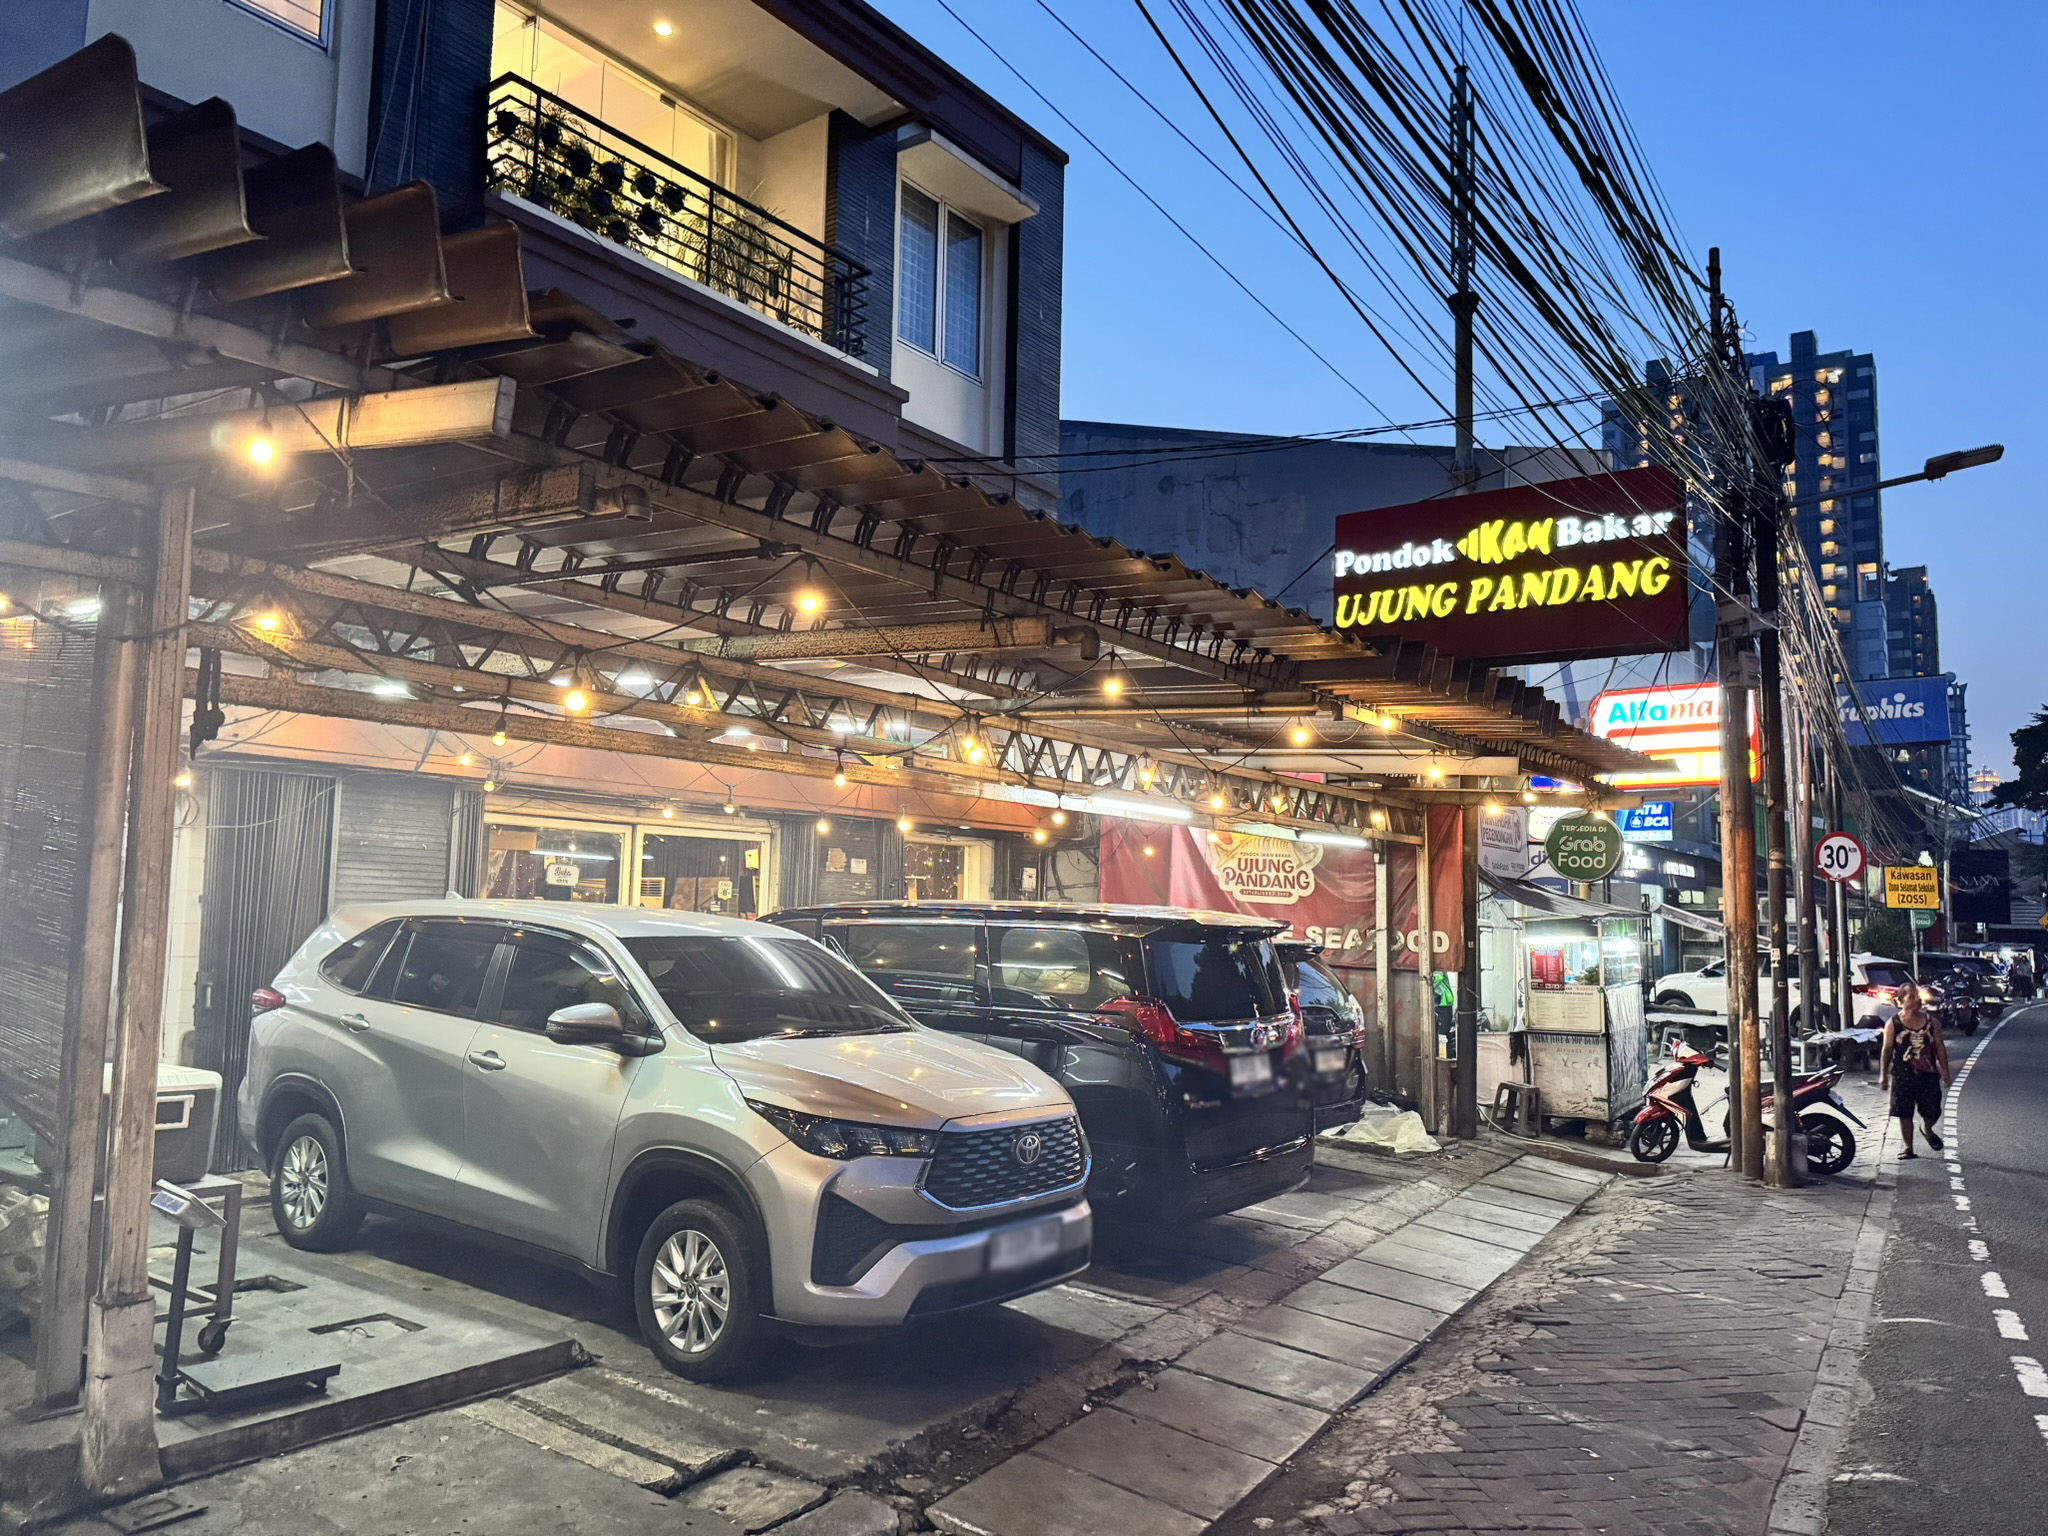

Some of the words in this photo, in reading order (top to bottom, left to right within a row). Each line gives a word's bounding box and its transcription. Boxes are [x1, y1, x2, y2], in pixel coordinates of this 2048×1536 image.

[1334, 537, 1456, 578] Pondok
[1556, 511, 1674, 547] Bakar
[1335, 580, 1459, 628] UJUNG
[1464, 556, 1671, 615] PANDANG
[1635, 804, 1663, 815] ATM
[1644, 816, 1669, 827] BCA
[1559, 836, 1606, 852] Grab
[1237, 857, 1294, 874] UJUNG
[1557, 852, 1606, 869] Food
[1823, 845, 1848, 869] 30
[1223, 866, 1310, 890] PANDANG
[1890, 870, 1932, 881] Kawasan
[1897, 893, 1927, 905] (ZOSS)
